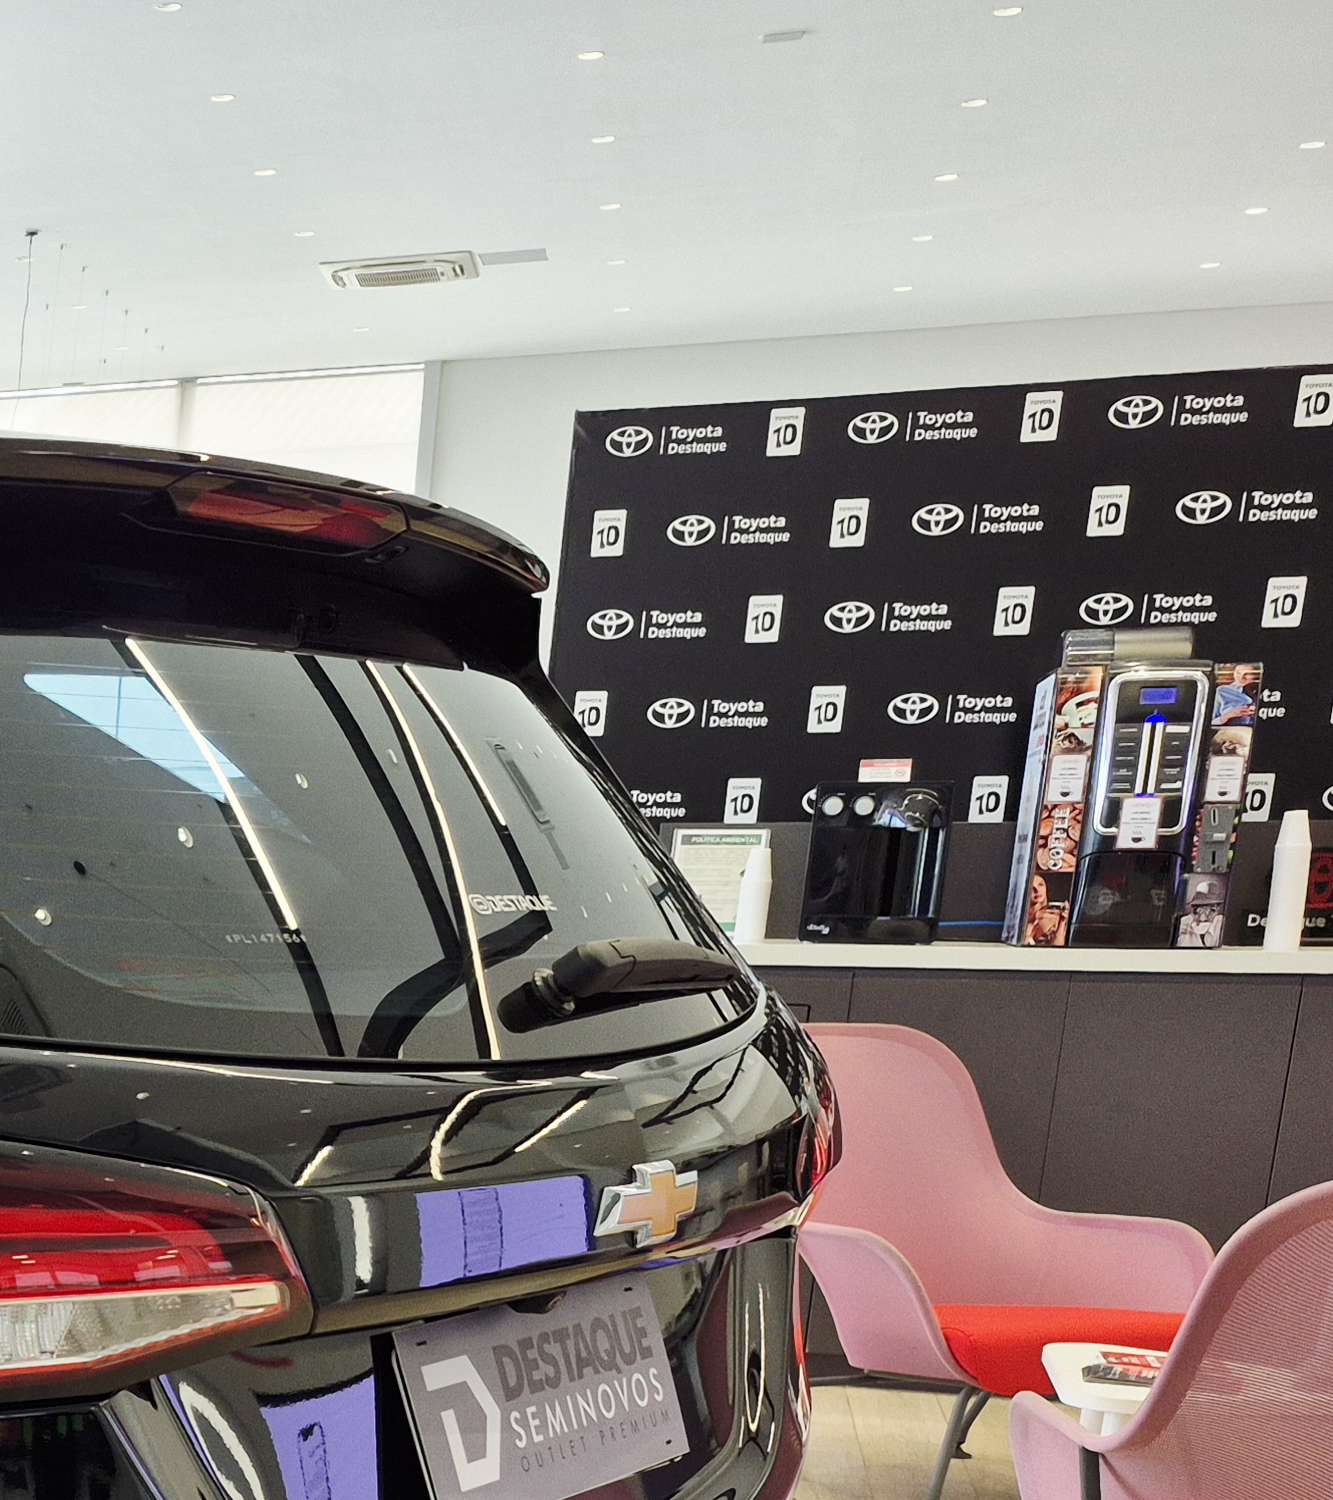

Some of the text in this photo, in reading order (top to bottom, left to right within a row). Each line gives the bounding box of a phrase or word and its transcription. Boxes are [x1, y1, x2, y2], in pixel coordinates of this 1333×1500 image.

[1183, 393, 1245, 411] Toyota
[917, 410, 974, 427] Toyota
[1180, 411, 1248, 426] Destaque
[670, 425, 723, 442] Toyota
[914, 427, 978, 441] Destaque
[668, 441, 727, 455] Destaque
[1251, 489, 1314, 507] Toyota
[982, 503, 1040, 520] Toyota
[1248, 508, 1318, 523] Destaque
[733, 515, 786, 531] Toyota
[979, 520, 1044, 534] Destaque
[730, 531, 790, 545] Destaque
[1153, 593, 1213, 610] Toyota
[650, 609, 703, 626] Toyota
[892, 602, 949, 619] Toyota
[1150, 610, 1217, 624] Destaque
[647, 626, 707, 640] Destaque
[889, 619, 952, 633] Destaque
[711, 699, 764, 715] Toyota
[956, 694, 1013, 711] Toyota
[709, 715, 769, 729] Destaque
[954, 711, 1017, 725] Destaque
[630, 790, 681, 806] Toyota
[639, 806, 686, 819] estaque
[1047, 807, 1071, 870] COFFEE
[493, 1306, 653, 1401] DESTAQUE
[510, 1367, 664, 1448] SEMINOVOS
[521, 1408, 671, 1472] OUTLET PREMIUM
